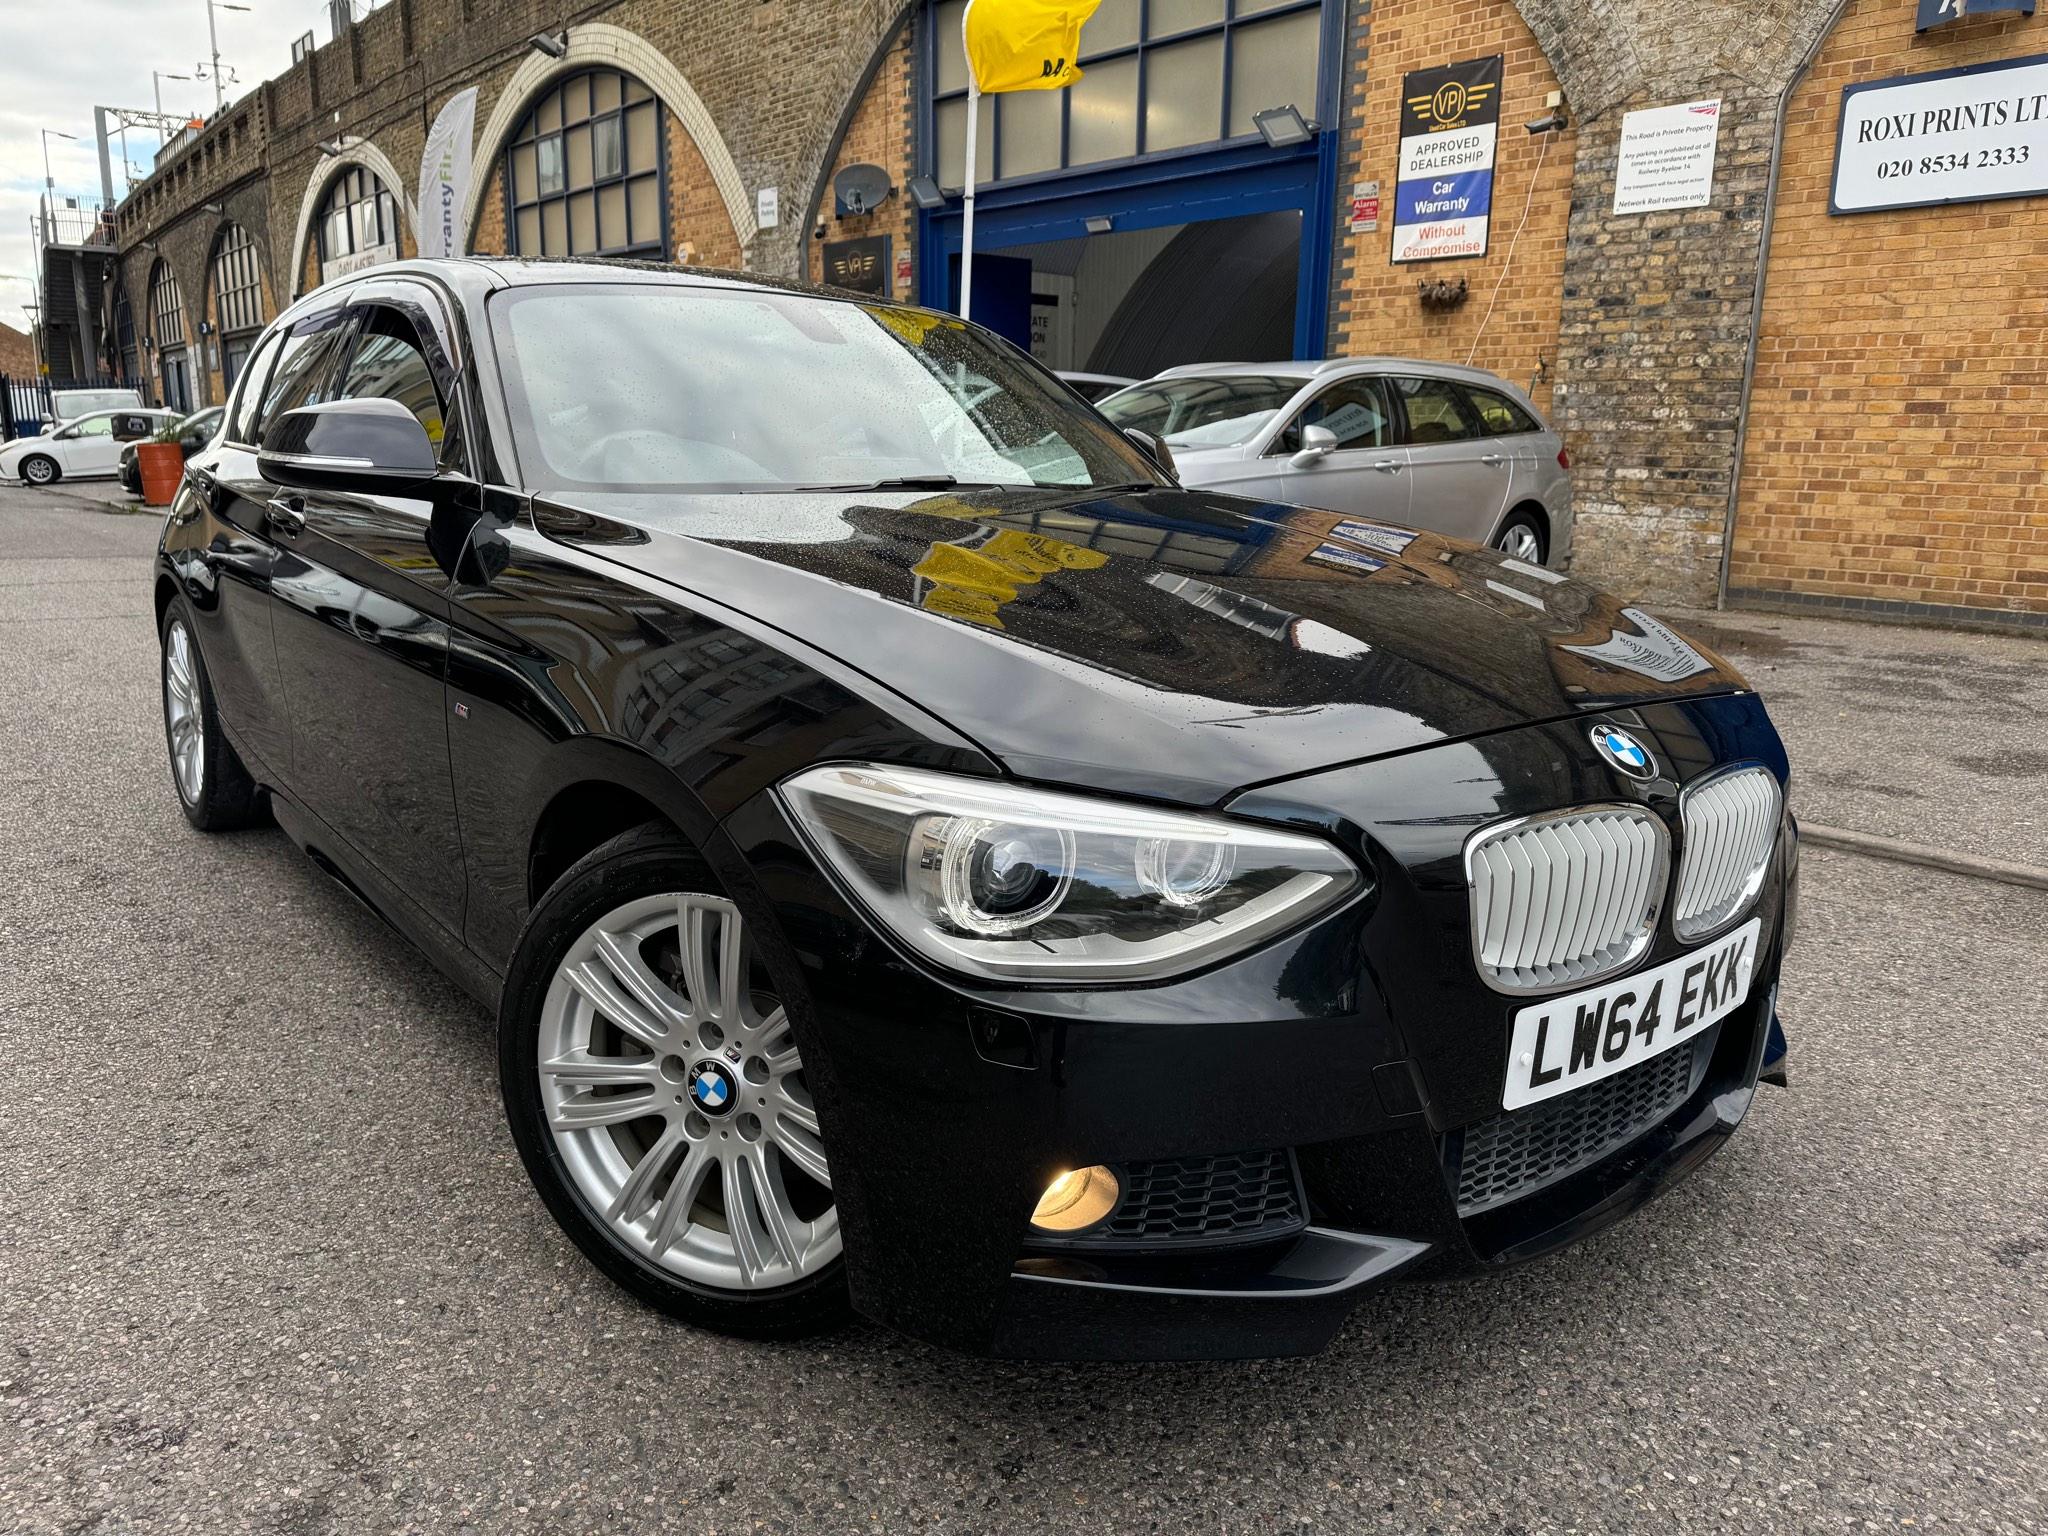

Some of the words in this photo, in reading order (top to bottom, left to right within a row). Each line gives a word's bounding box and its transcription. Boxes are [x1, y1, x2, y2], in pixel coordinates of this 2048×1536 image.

[1438, 90, 1462, 115] VPI
[1857, 112, 1917, 144] ROXI
[1920, 99, 2009, 136] PRINTS
[2014, 93, 2048, 123] LT
[1638, 132, 1655, 140] Road
[1662, 128, 1685, 136] Private
[1685, 124, 1714, 135] Property
[1416, 136, 1480, 156] APPROVED
[1636, 150, 1657, 159] parking
[1664, 144, 1694, 155] prohibited
[1410, 150, 1484, 171] DEALERSHIP
[1654, 155, 1686, 164] accordance
[1877, 158, 1913, 180] 020
[1919, 152, 1970, 175] 8534
[1976, 145, 2030, 168] 2333
[1638, 167, 1660, 175] Railway
[1432, 181, 1455, 195] Car
[1354, 200, 1378, 209] Alarm
[1414, 196, 1470, 215] Warranty
[1618, 198, 1646, 208] Network
[1647, 197, 1660, 205] Rail
[1662, 194, 1688, 203] tenants
[1689, 192, 1706, 202] only
[1418, 224, 1466, 240] Without
[1402, 240, 1480, 258] Compromise
[202, 322, 207, 334] 3
[1528, 977, 1665, 1090] LW64
[1673, 935, 1748, 1034] EKK
